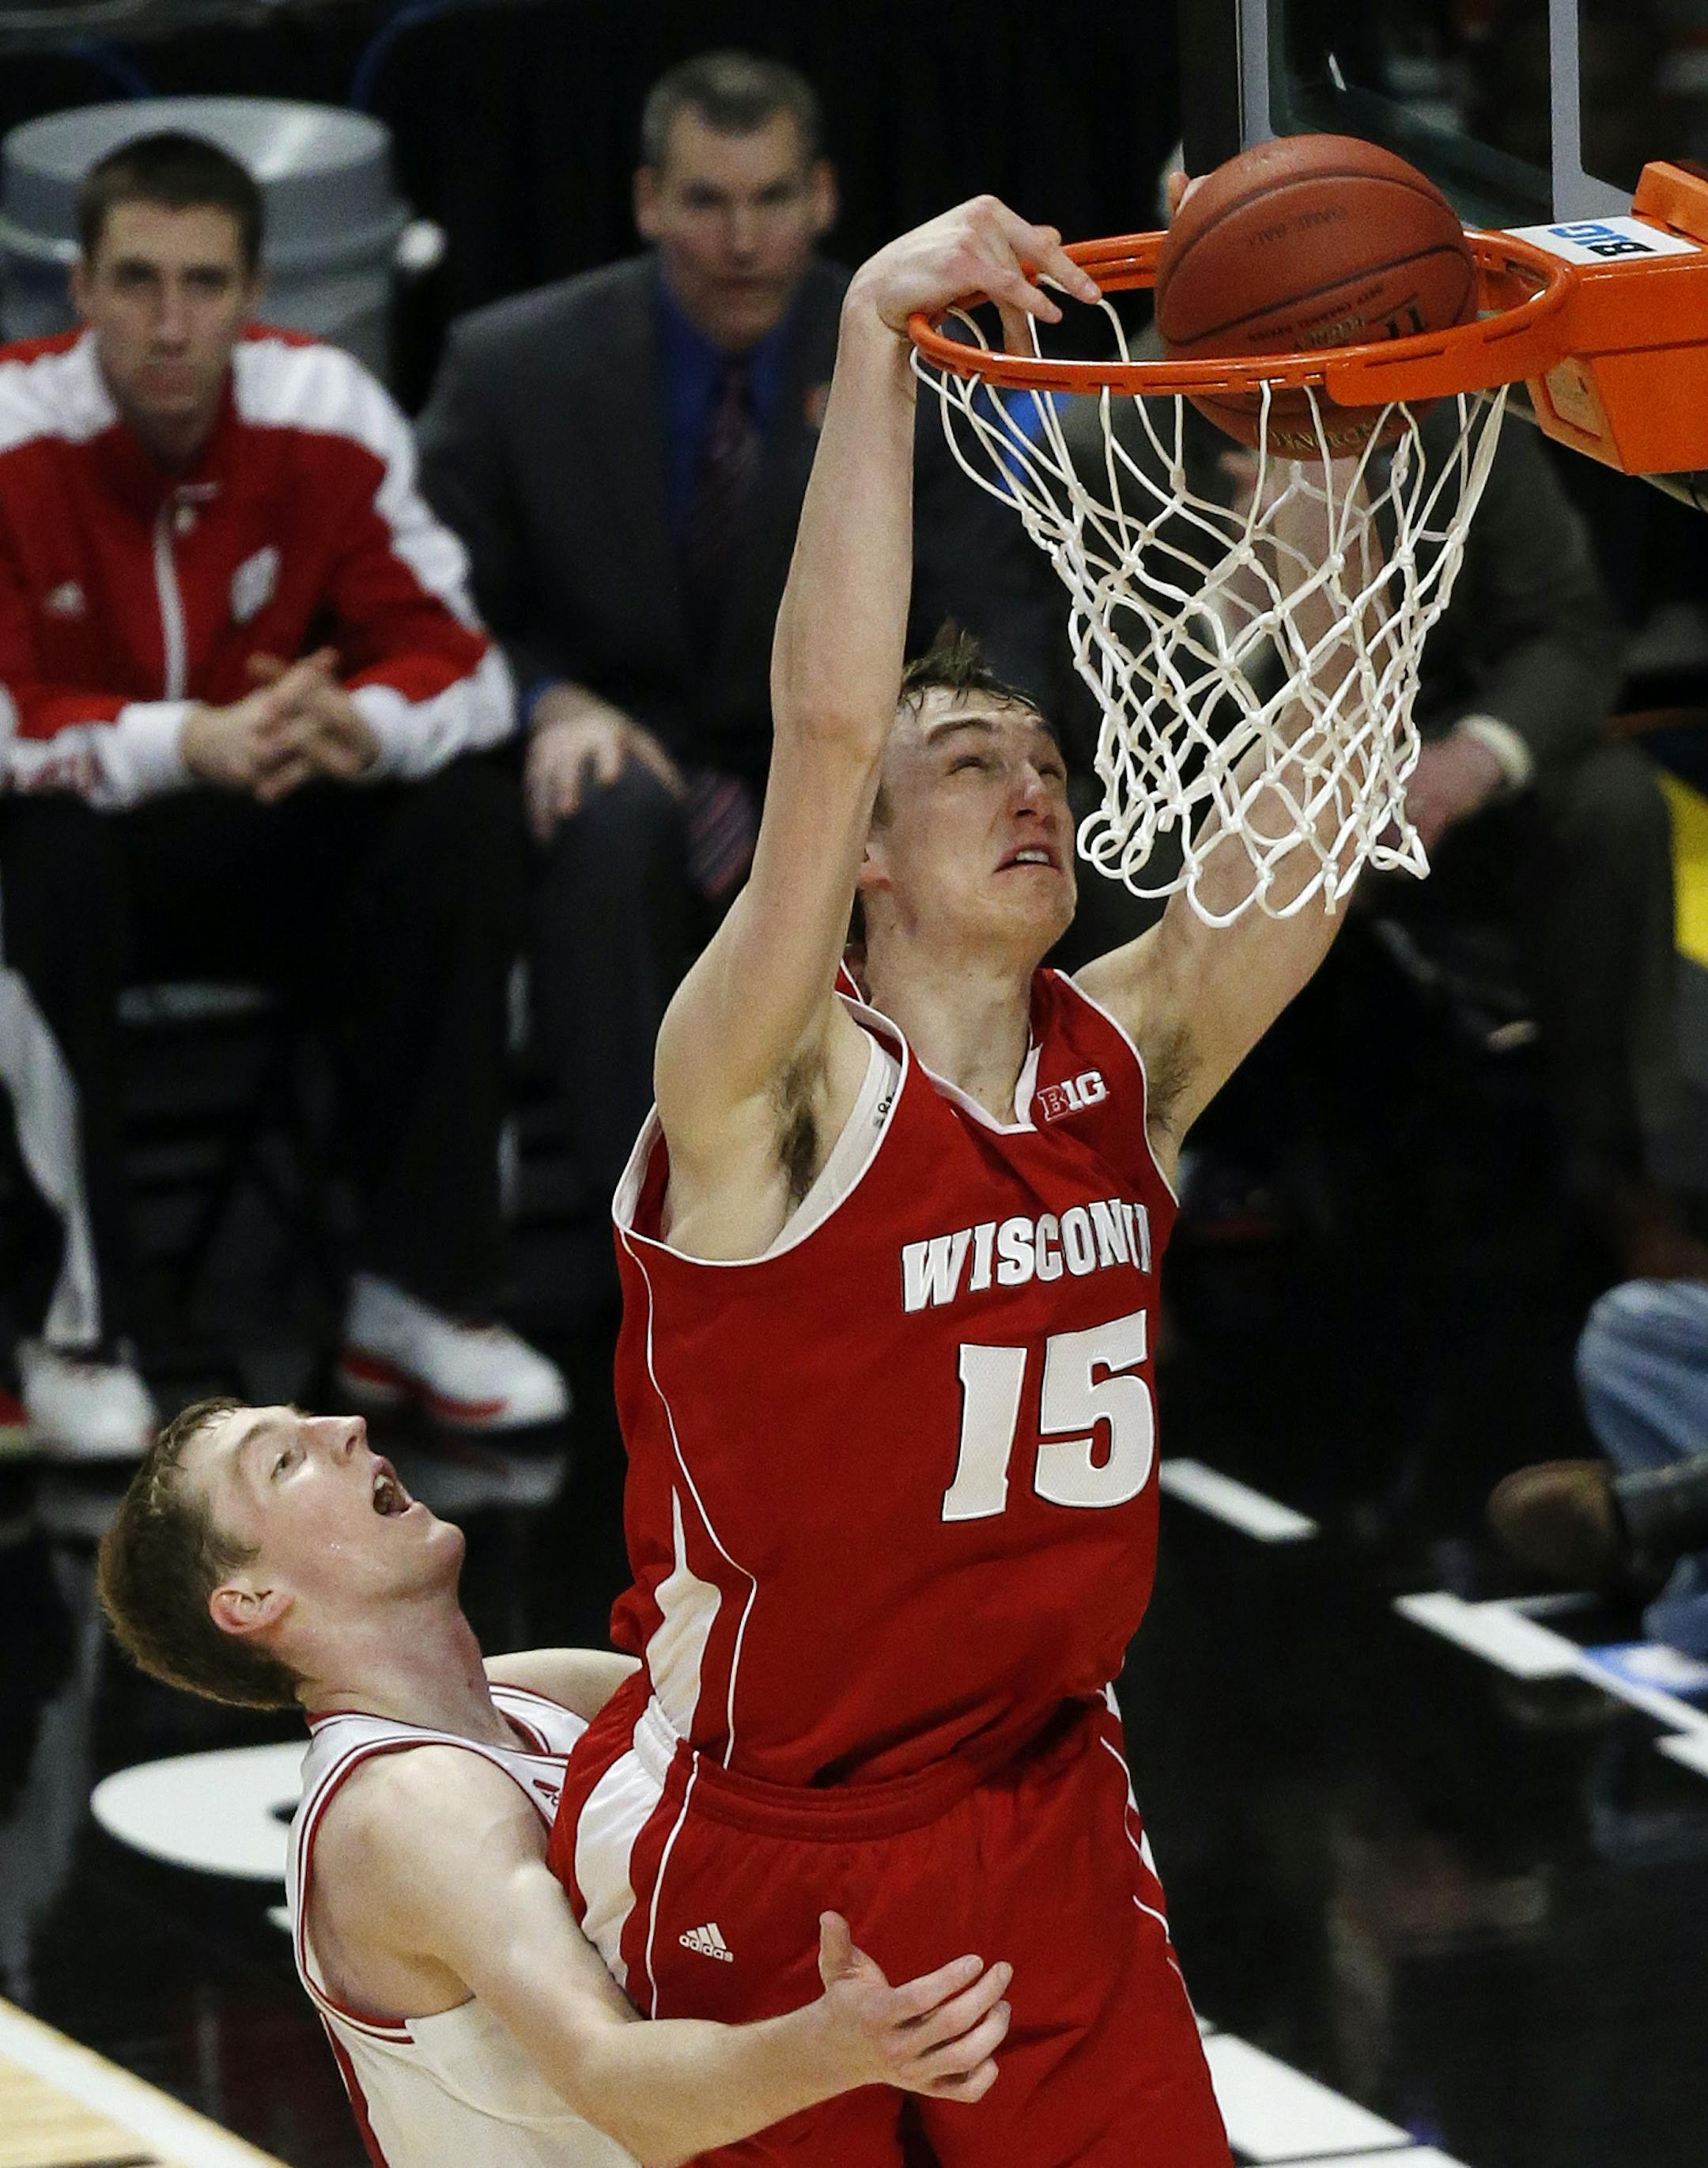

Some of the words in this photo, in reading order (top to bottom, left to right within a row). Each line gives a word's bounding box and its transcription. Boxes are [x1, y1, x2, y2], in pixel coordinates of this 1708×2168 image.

[901, 1198, 1152, 1314] WISCON
[942, 1308, 1154, 1522] 15
[678, 1935, 734, 1963] adidas
